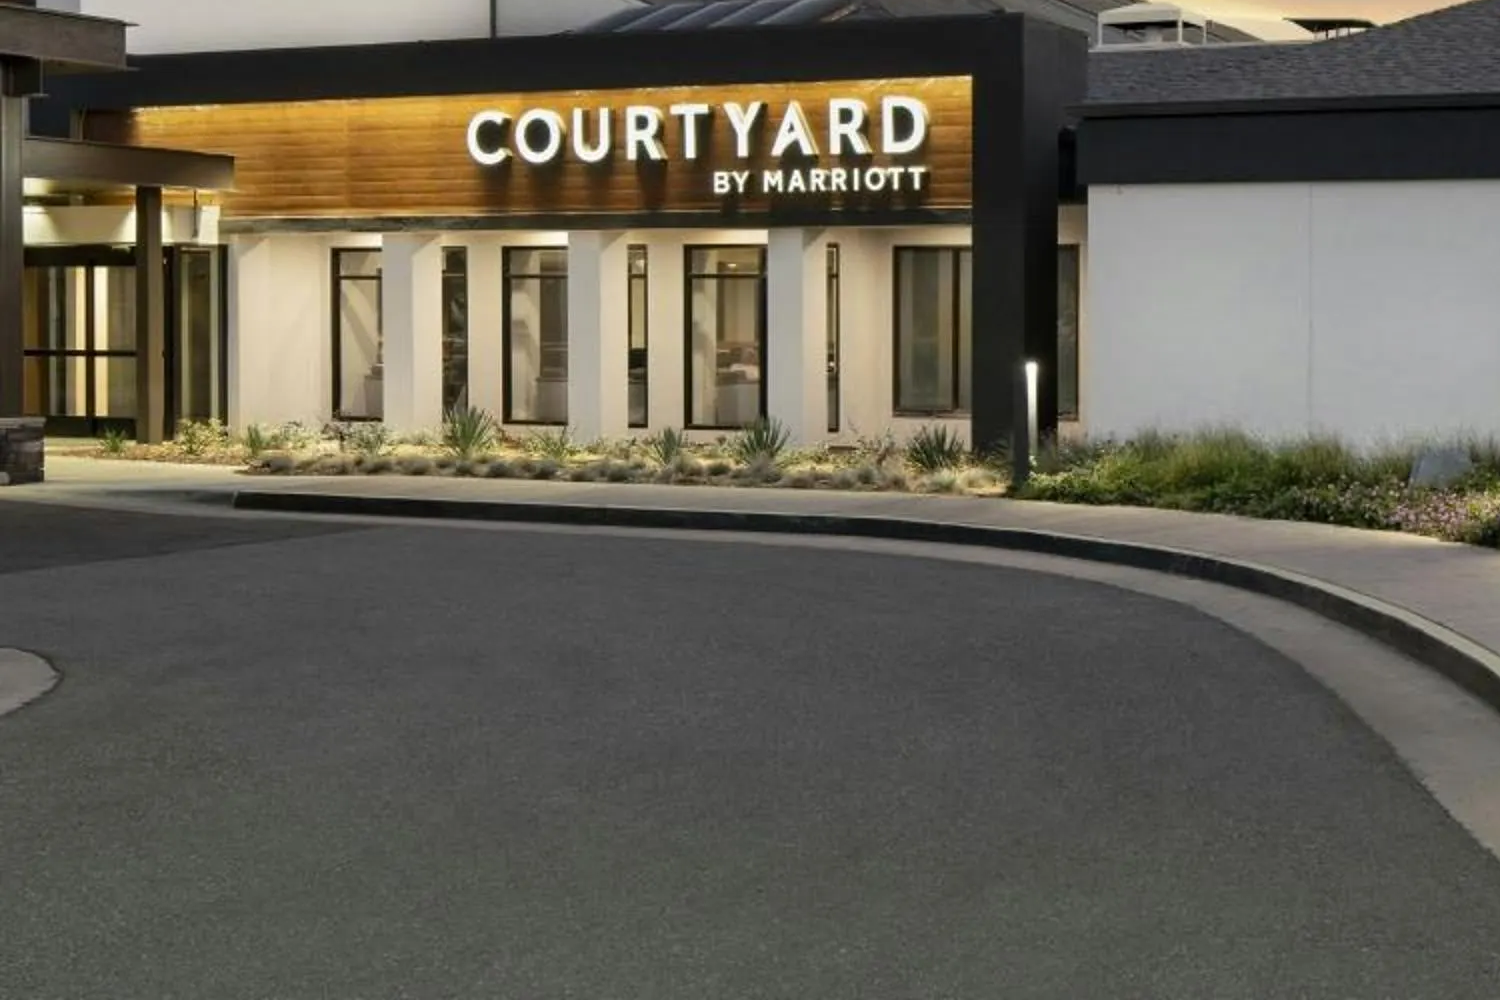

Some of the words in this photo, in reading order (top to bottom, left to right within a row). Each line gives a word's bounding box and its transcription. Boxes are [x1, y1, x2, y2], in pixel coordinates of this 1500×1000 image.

[466, 96, 930, 165] COURTYARD
[713, 170, 750, 194] BY
[763, 166, 927, 193] MARRIOTT
